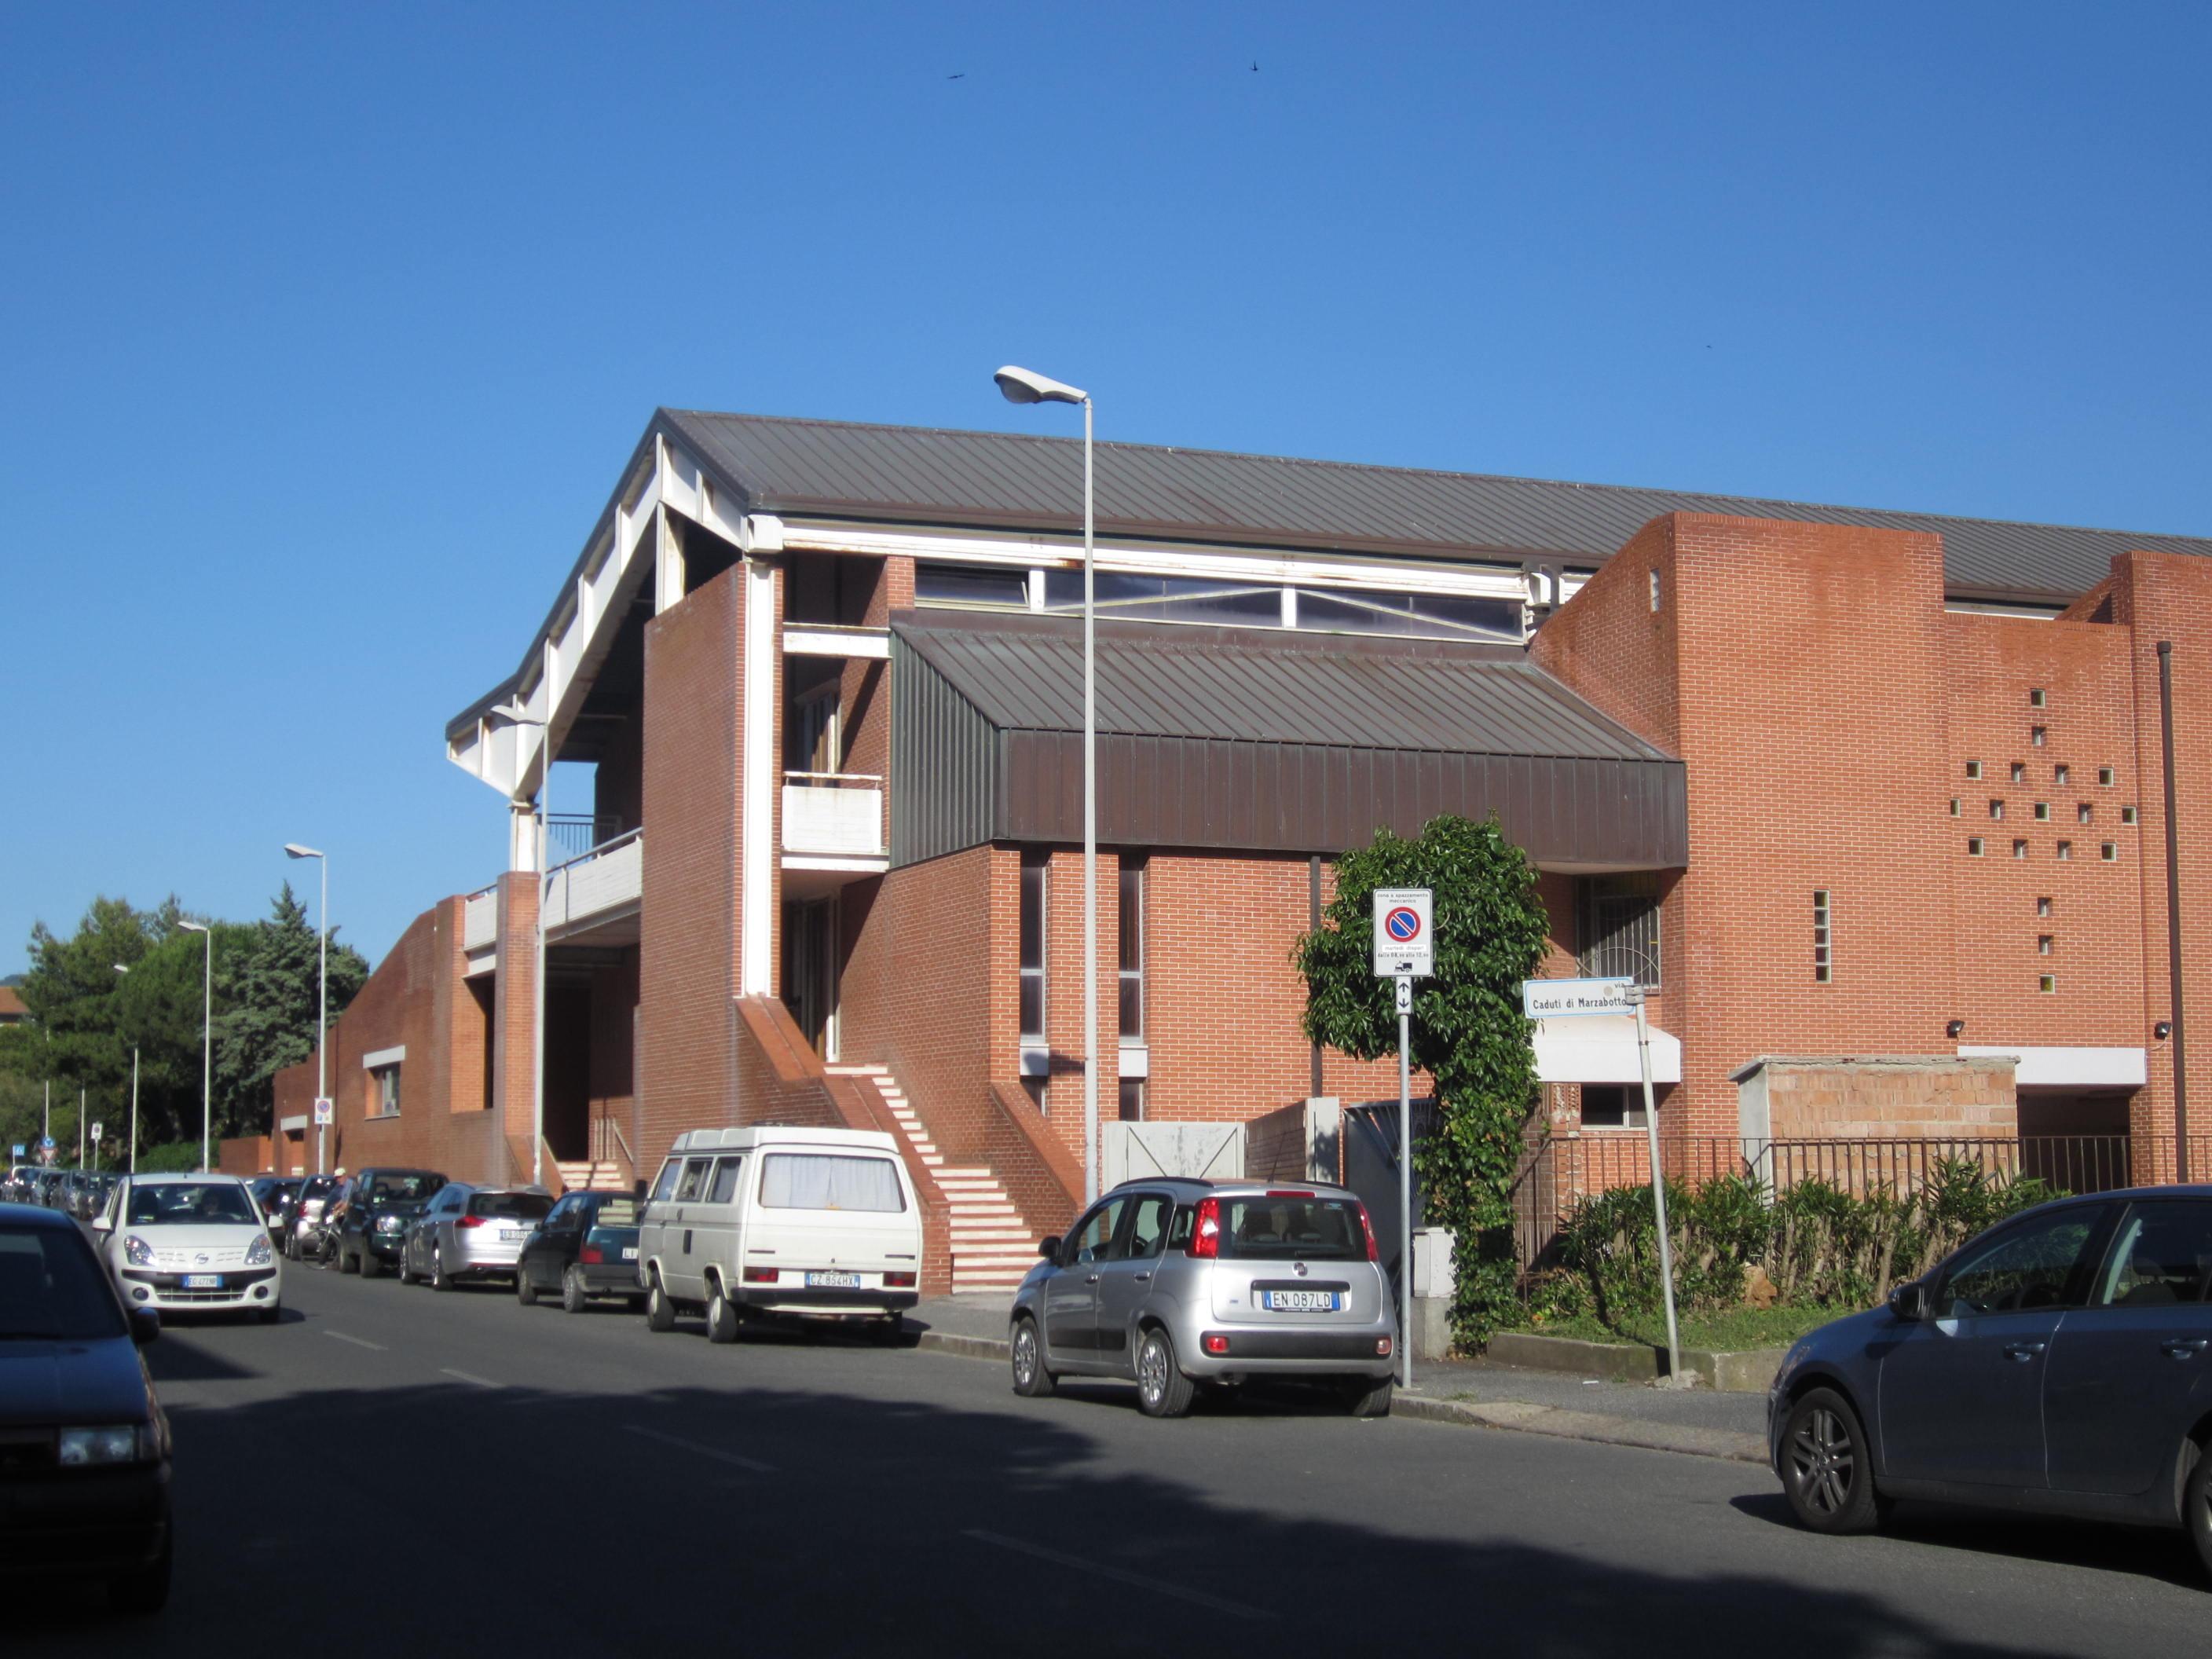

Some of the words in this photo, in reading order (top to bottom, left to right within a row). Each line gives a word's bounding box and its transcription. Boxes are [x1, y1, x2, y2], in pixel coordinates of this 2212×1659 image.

[1533, 999, 1562, 1009] Caduti
[1566, 998, 1574, 1008] di
[1578, 997, 1627, 1007] Marzabotto
[1273, 1292, 1288, 1306] EN
[1293, 1293, 1331, 1307] 087LD
